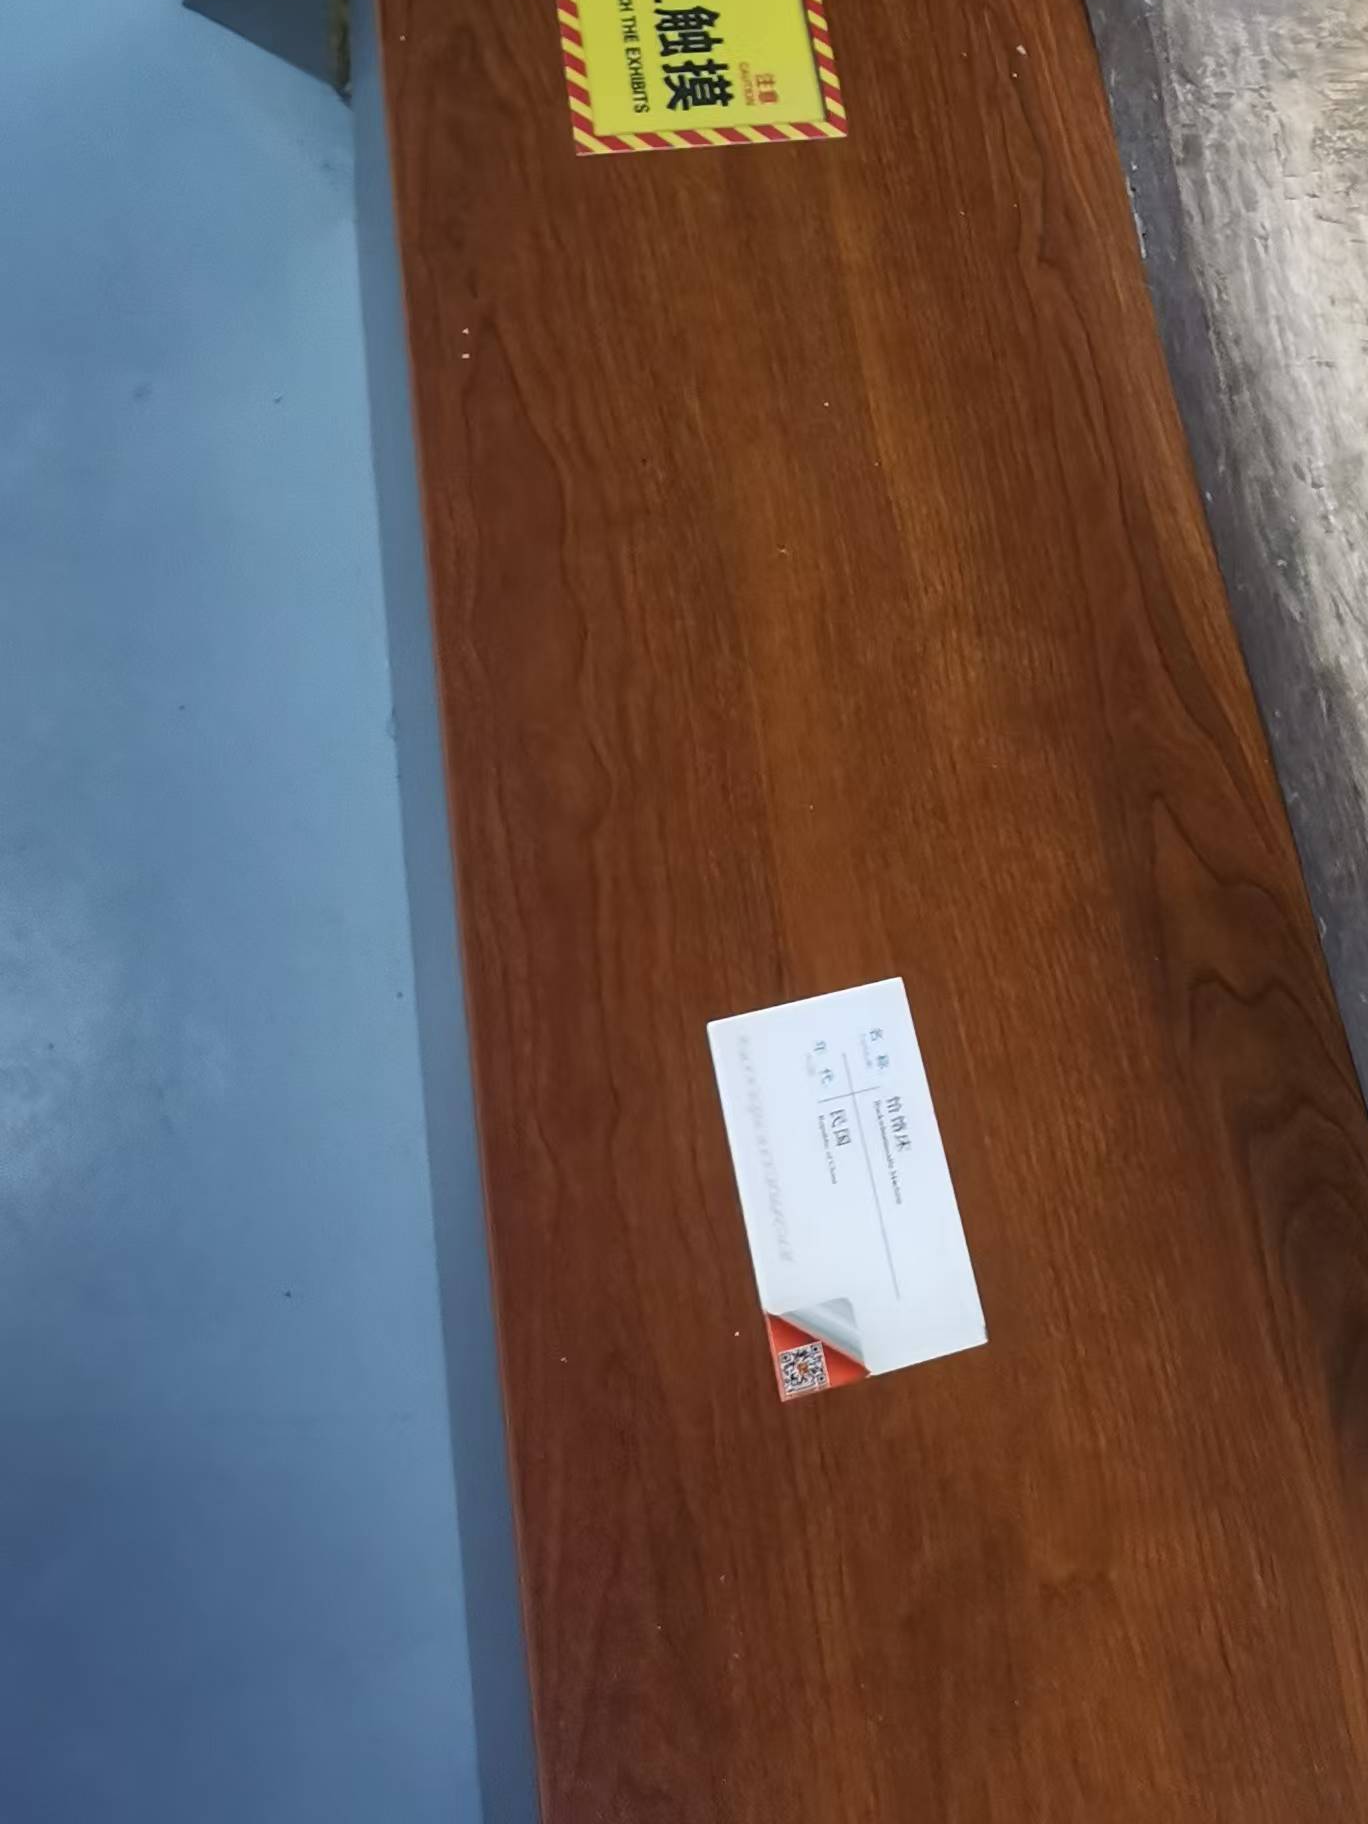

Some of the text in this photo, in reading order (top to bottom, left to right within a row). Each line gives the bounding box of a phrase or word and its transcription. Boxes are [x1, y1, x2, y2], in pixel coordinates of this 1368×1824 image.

[619, 14, 637, 43] THE
[625, 45, 649, 114] EXHIBITS
[830, 1109, 851, 1146] 民国
